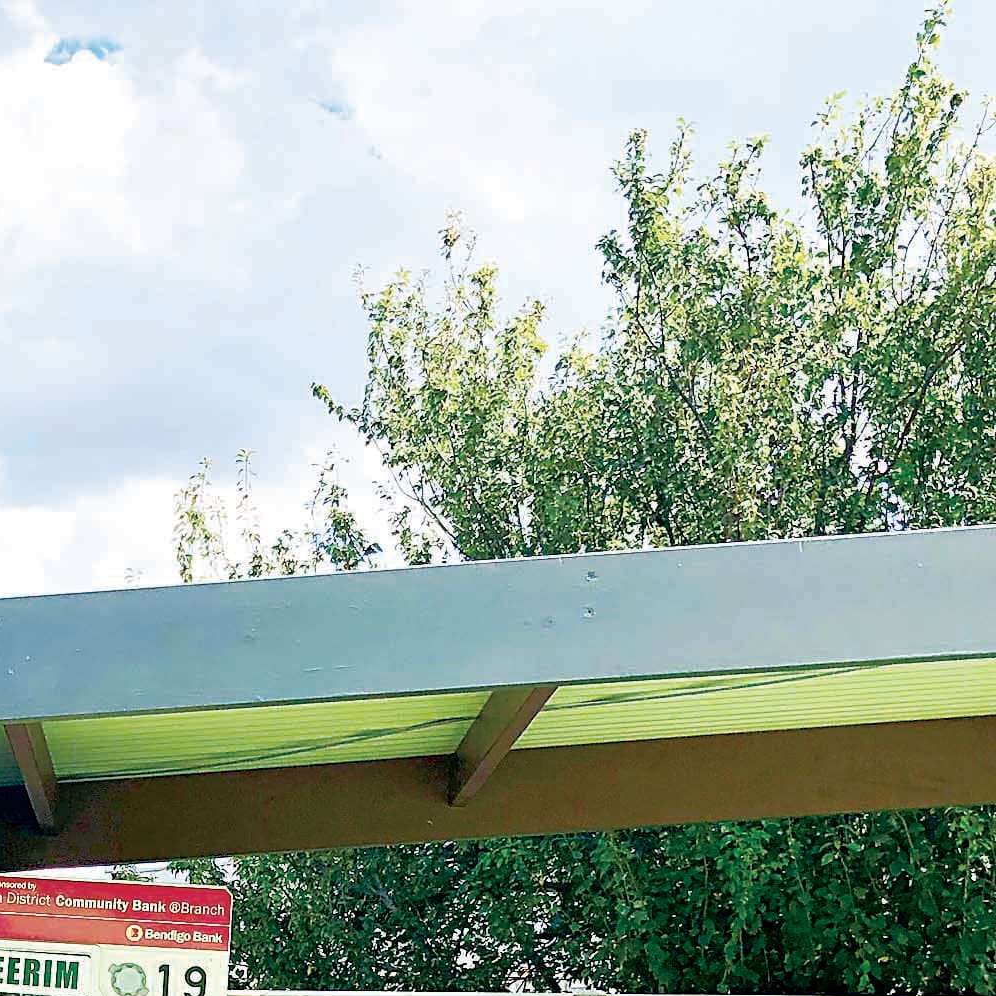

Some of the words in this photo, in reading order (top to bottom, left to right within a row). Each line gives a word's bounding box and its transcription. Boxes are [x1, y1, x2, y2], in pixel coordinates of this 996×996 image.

[28, 882, 37, 892] by
[7, 892, 51, 907] District
[56, 894, 129, 913] Community
[132, 899, 166, 913] Bank
[144, 928, 192, 944] Bendigo
[193, 931, 223, 944] Bank
